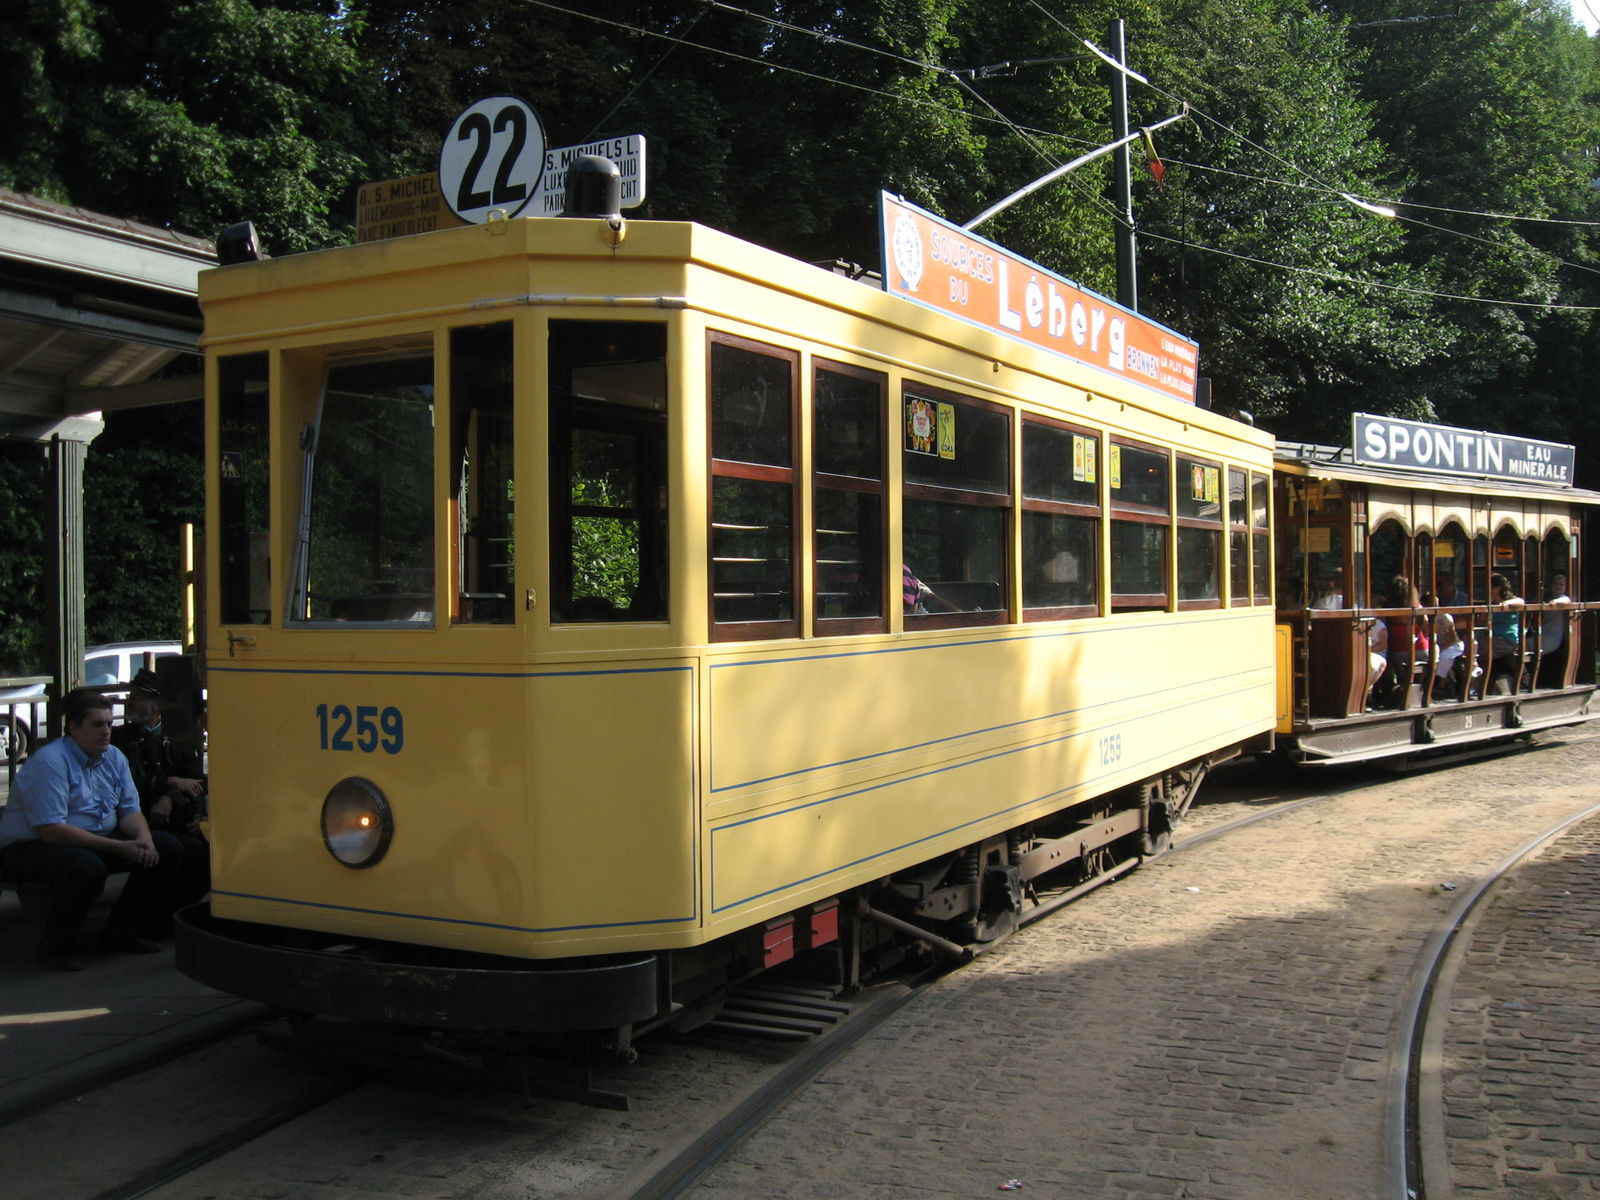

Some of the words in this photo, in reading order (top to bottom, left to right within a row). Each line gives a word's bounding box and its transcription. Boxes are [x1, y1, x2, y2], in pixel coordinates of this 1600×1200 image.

[457, 104, 527, 212] 22
[546, 153, 557, 171] S.
[626, 137, 639, 155] L.
[390, 177, 437, 201] MICHEL
[931, 229, 993, 284] SOURCES
[950, 276, 968, 305] DU
[1128, 344, 1160, 379] BRONNEN
[1364, 422, 1504, 472] SPONTIN
[1527, 445, 1551, 462] EAU
[1508, 459, 1568, 480] MINERALE
[316, 703, 404, 755] 1259
[1099, 733, 1121, 768] 1259
